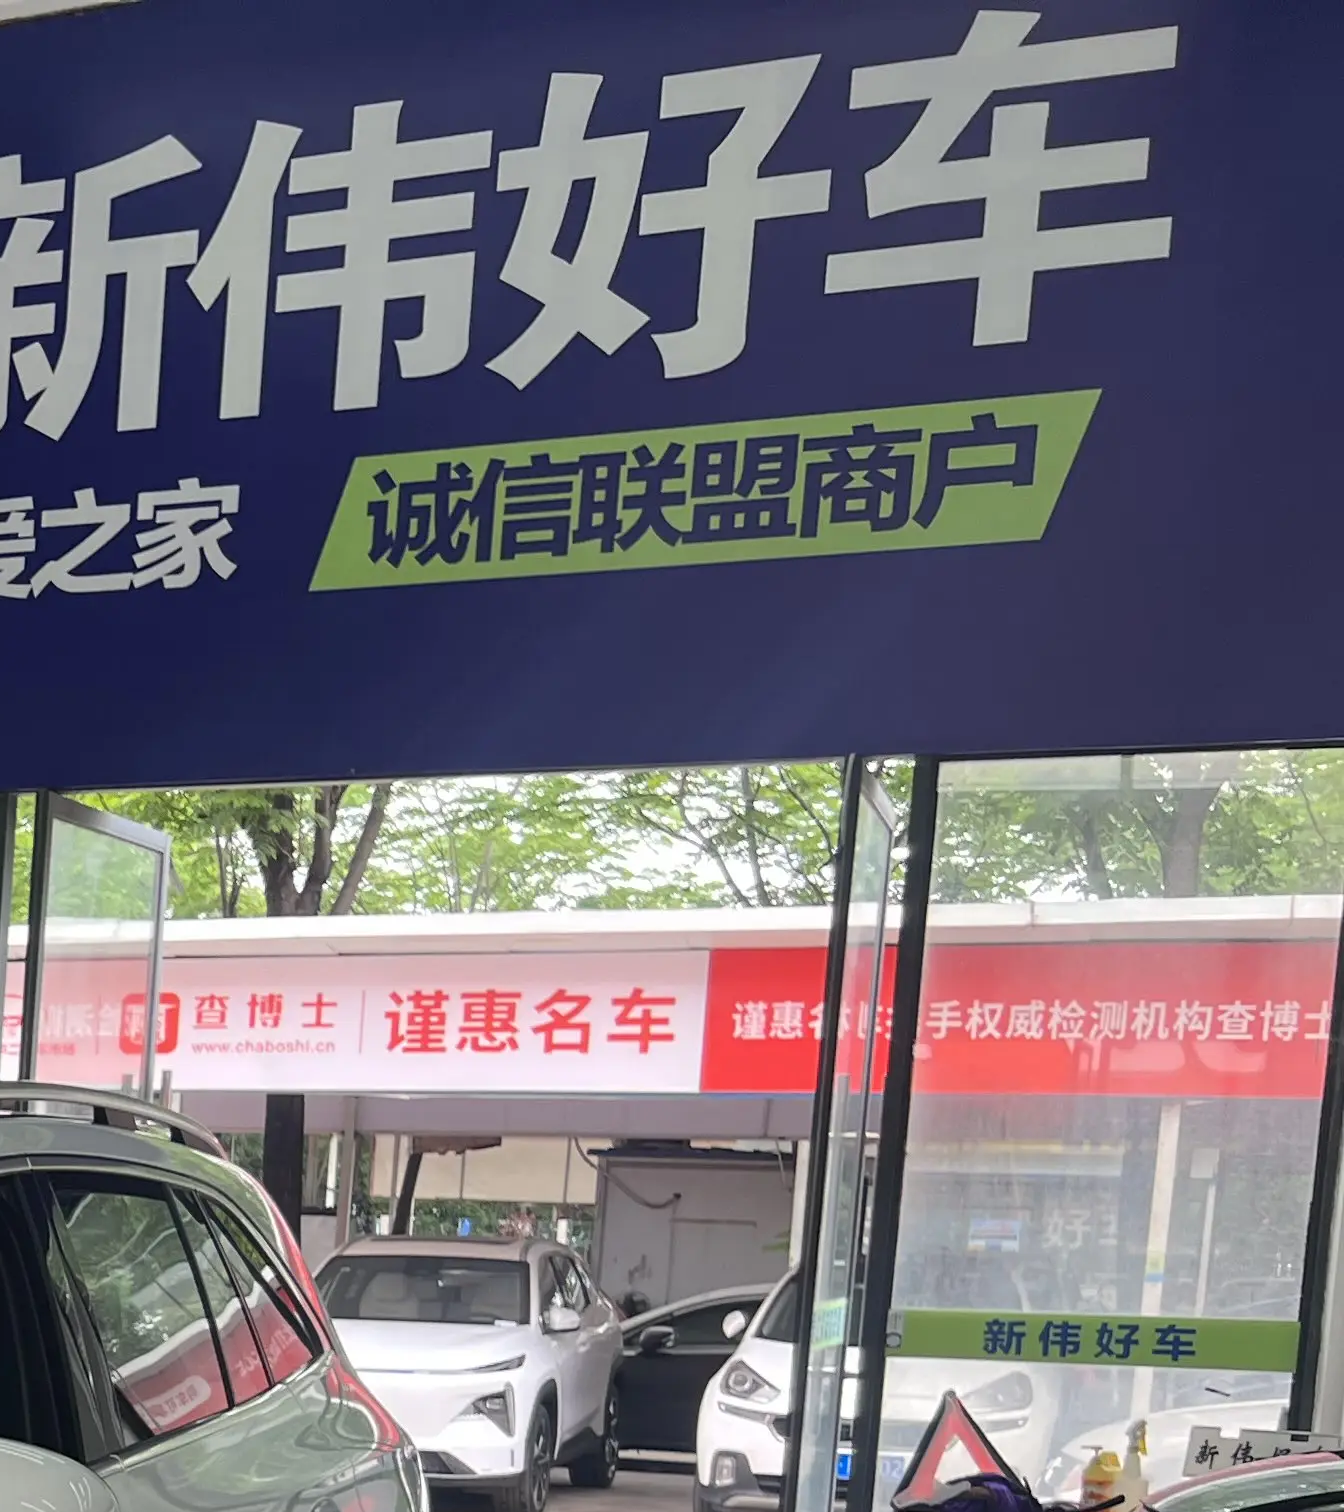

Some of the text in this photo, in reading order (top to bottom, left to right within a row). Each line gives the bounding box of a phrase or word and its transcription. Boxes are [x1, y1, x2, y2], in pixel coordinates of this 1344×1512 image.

[365, 412, 1041, 567] 诚信联盟商户
[192, 992, 338, 1030] 查博士
[385, 988, 676, 1056] 谨惠名车
[191, 1039, 336, 1055] www.chaboshi.cn
[982, 1318, 1198, 1362] 新伟好车
